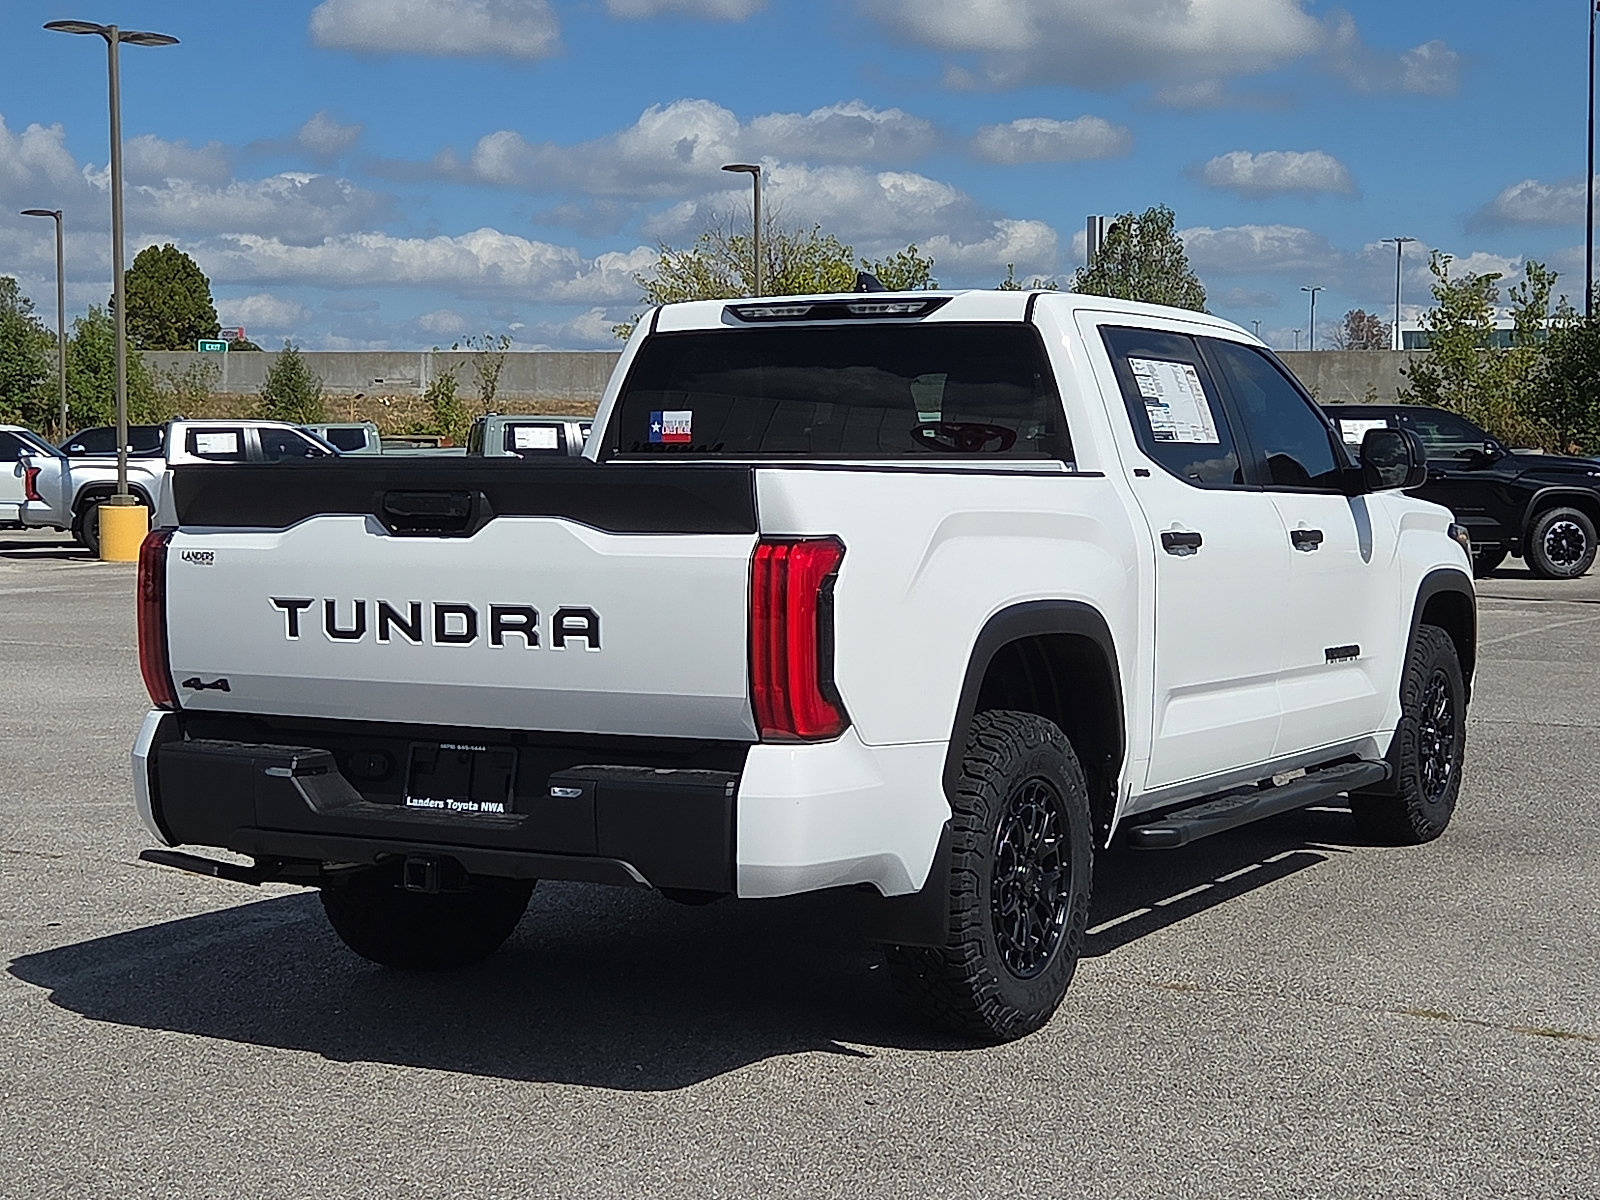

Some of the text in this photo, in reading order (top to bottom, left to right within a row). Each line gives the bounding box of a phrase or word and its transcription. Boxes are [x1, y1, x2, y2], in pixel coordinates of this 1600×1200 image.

[205, 343, 221, 351] EXIT
[181, 550, 215, 562] LANDERS
[268, 596, 602, 652] TUNDRA
[406, 796, 505, 813] Landers Toyota NWA
